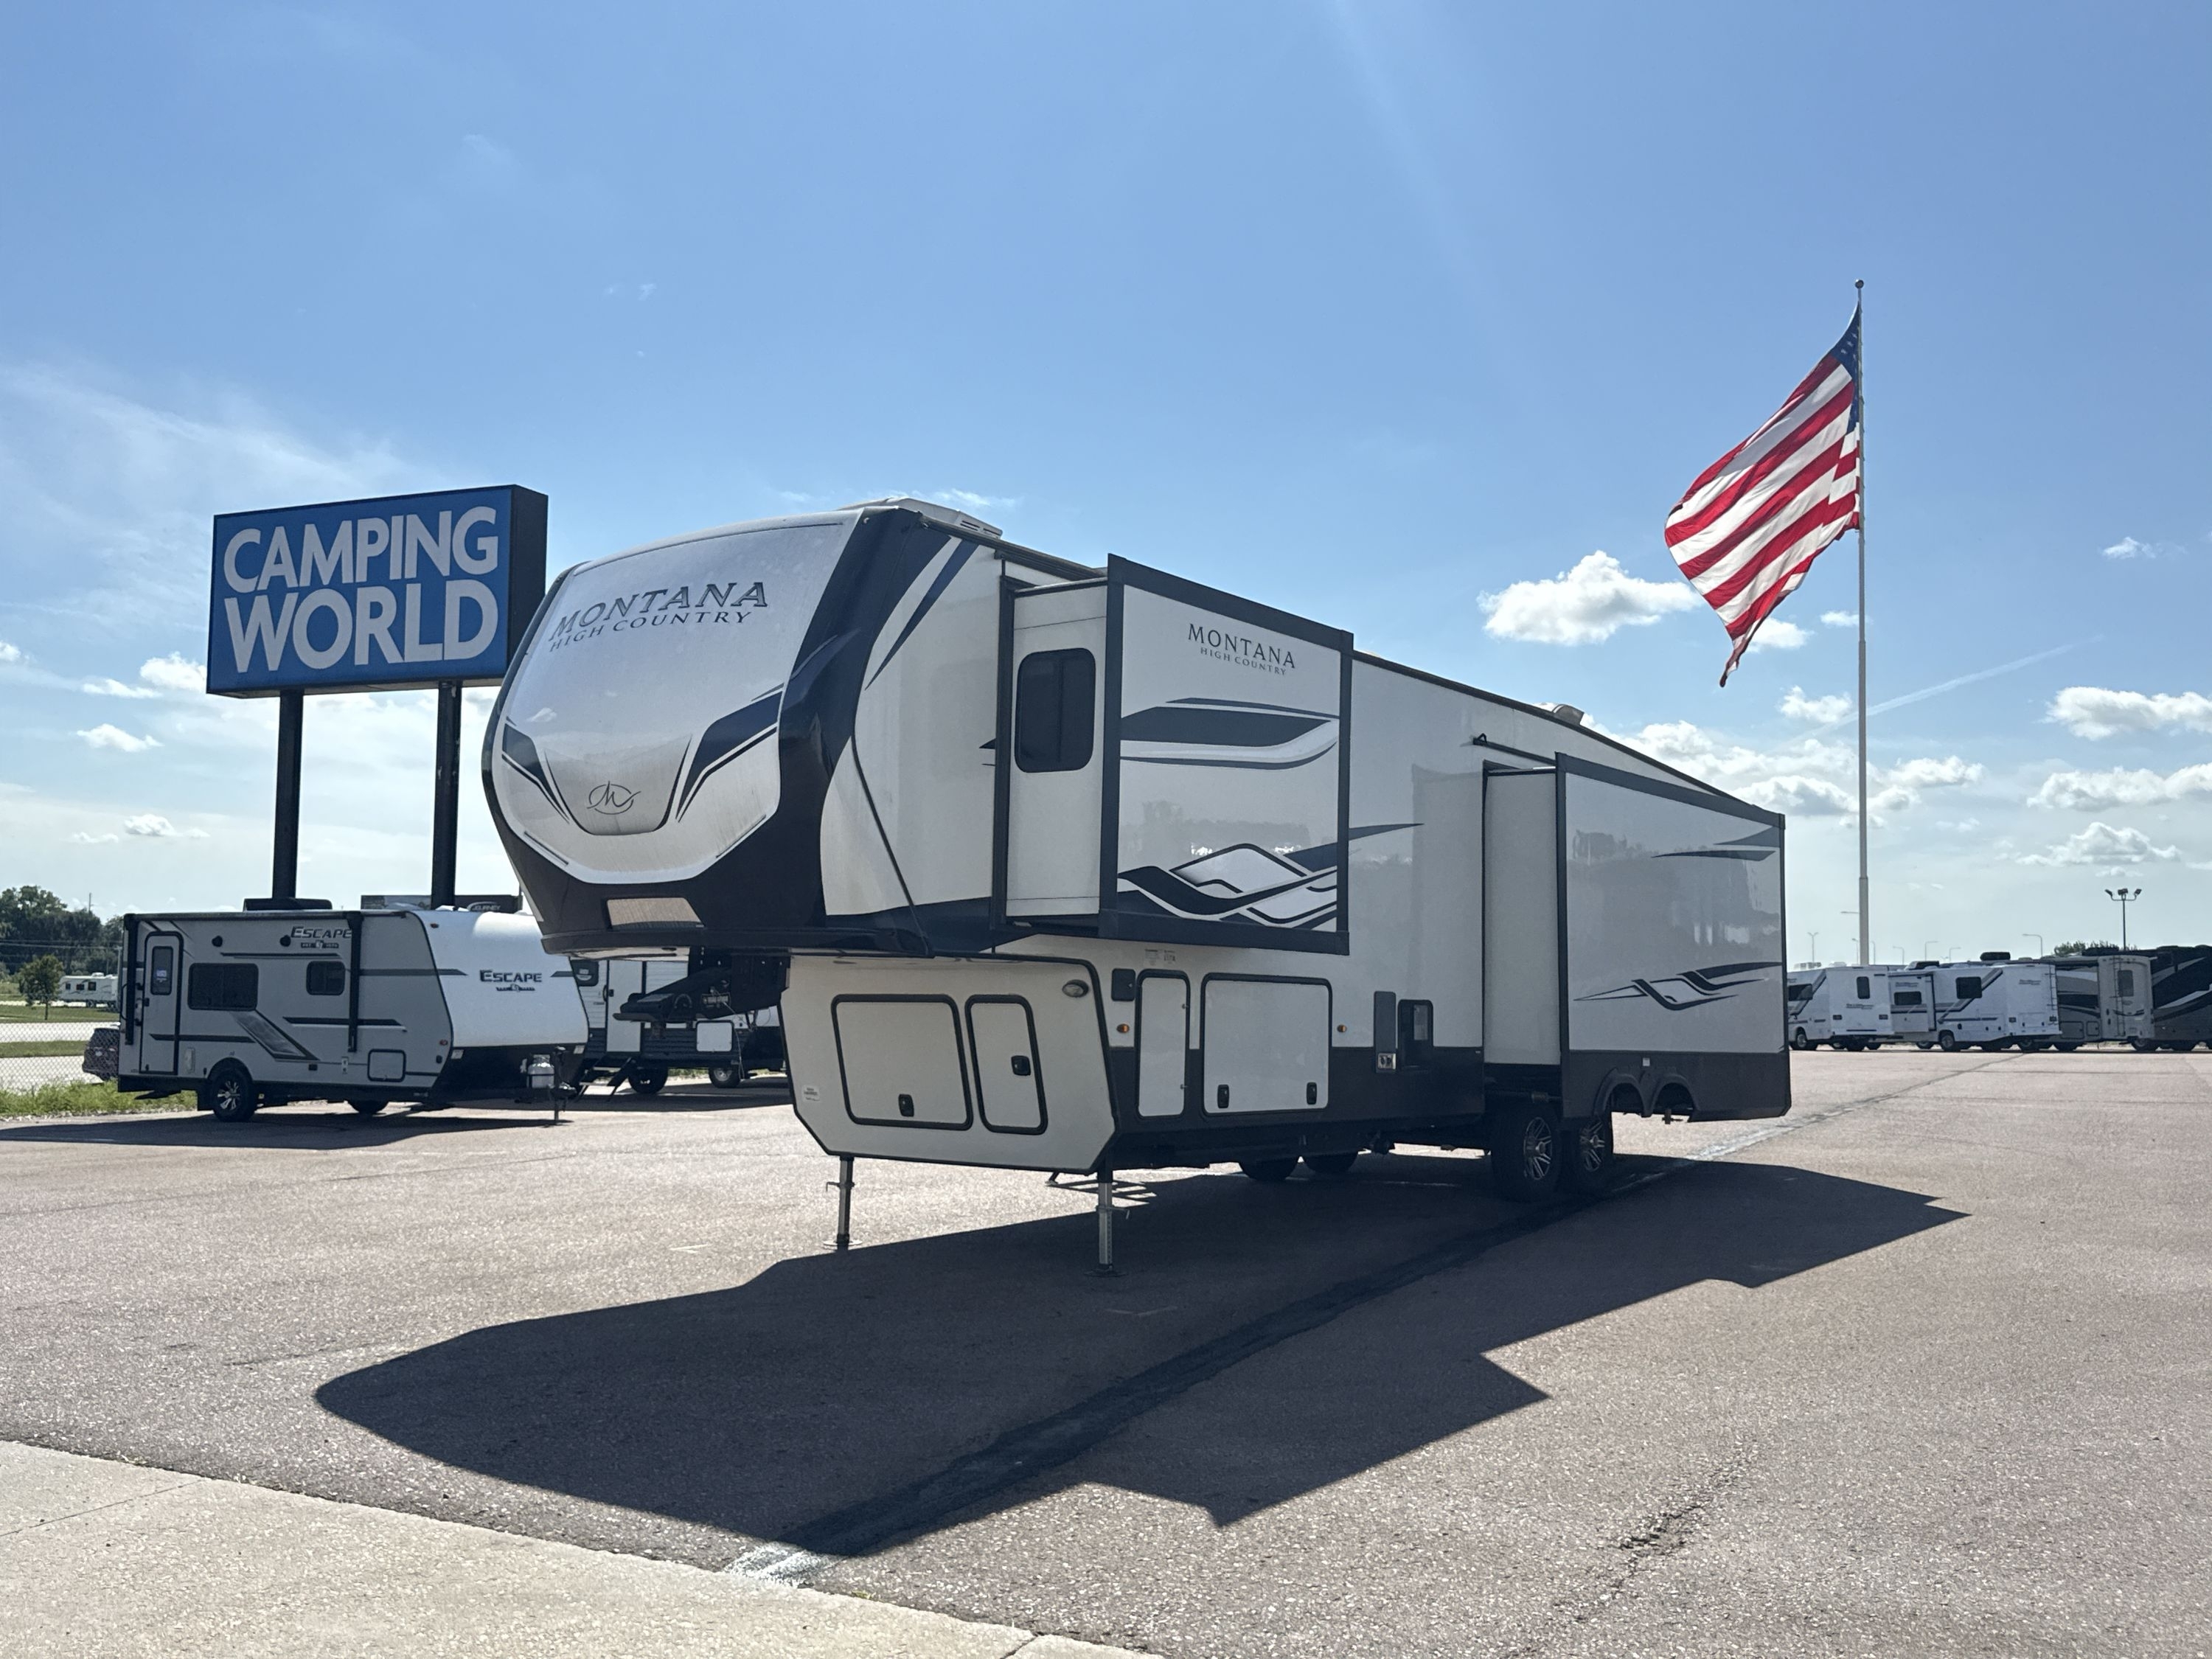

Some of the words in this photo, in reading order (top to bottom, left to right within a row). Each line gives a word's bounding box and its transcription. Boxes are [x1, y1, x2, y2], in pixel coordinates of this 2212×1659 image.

[223, 506, 498, 594] CAMPING
[224, 580, 498, 673] WORLD
[549, 582, 768, 641] MONTANA
[549, 625, 605, 652] HIGH
[613, 611, 752, 632] COUNTRY
[1188, 623, 1295, 669] MONTANA
[1200, 647, 1231, 661] HIGH
[1234, 656, 1286, 675] COUNTRY
[291, 926, 352, 939] ESCAPE
[479, 970, 542, 982] ESCAPE
